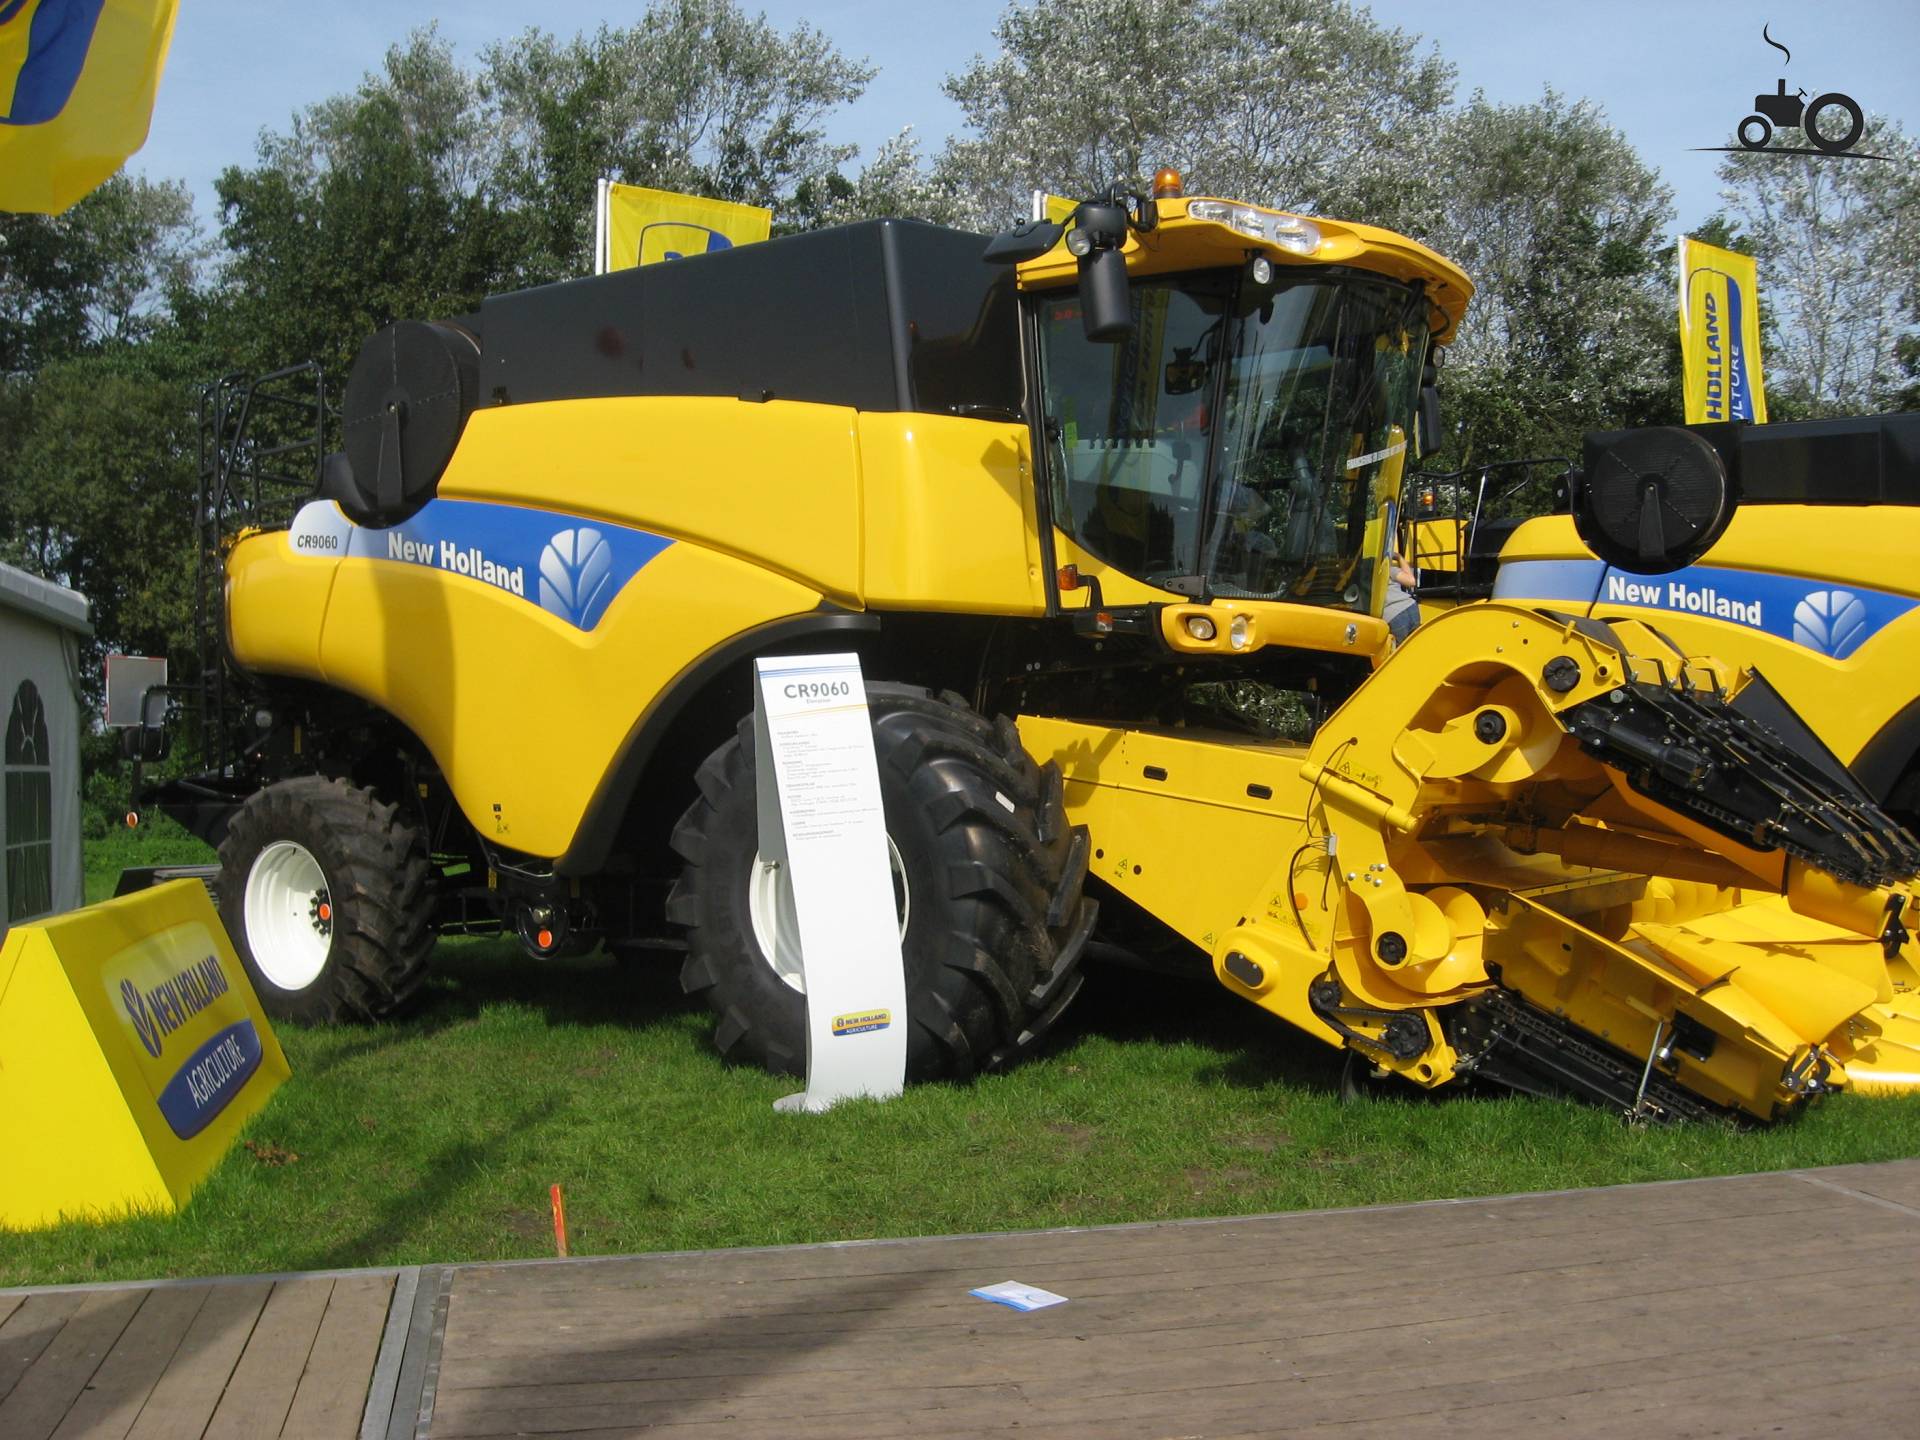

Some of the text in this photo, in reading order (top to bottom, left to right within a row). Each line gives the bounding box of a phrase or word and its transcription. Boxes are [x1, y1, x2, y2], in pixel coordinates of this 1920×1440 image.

[1705, 292, 1722, 420] HOLLAND
[297, 534, 338, 549] CR9060
[388, 531, 524, 597] New Holland
[1608, 576, 1763, 627] New Holland
[783, 681, 849, 699] CR9060
[146, 954, 229, 1038] NEW HOLLAND
[185, 1034, 246, 1110] AGRICULTURE
